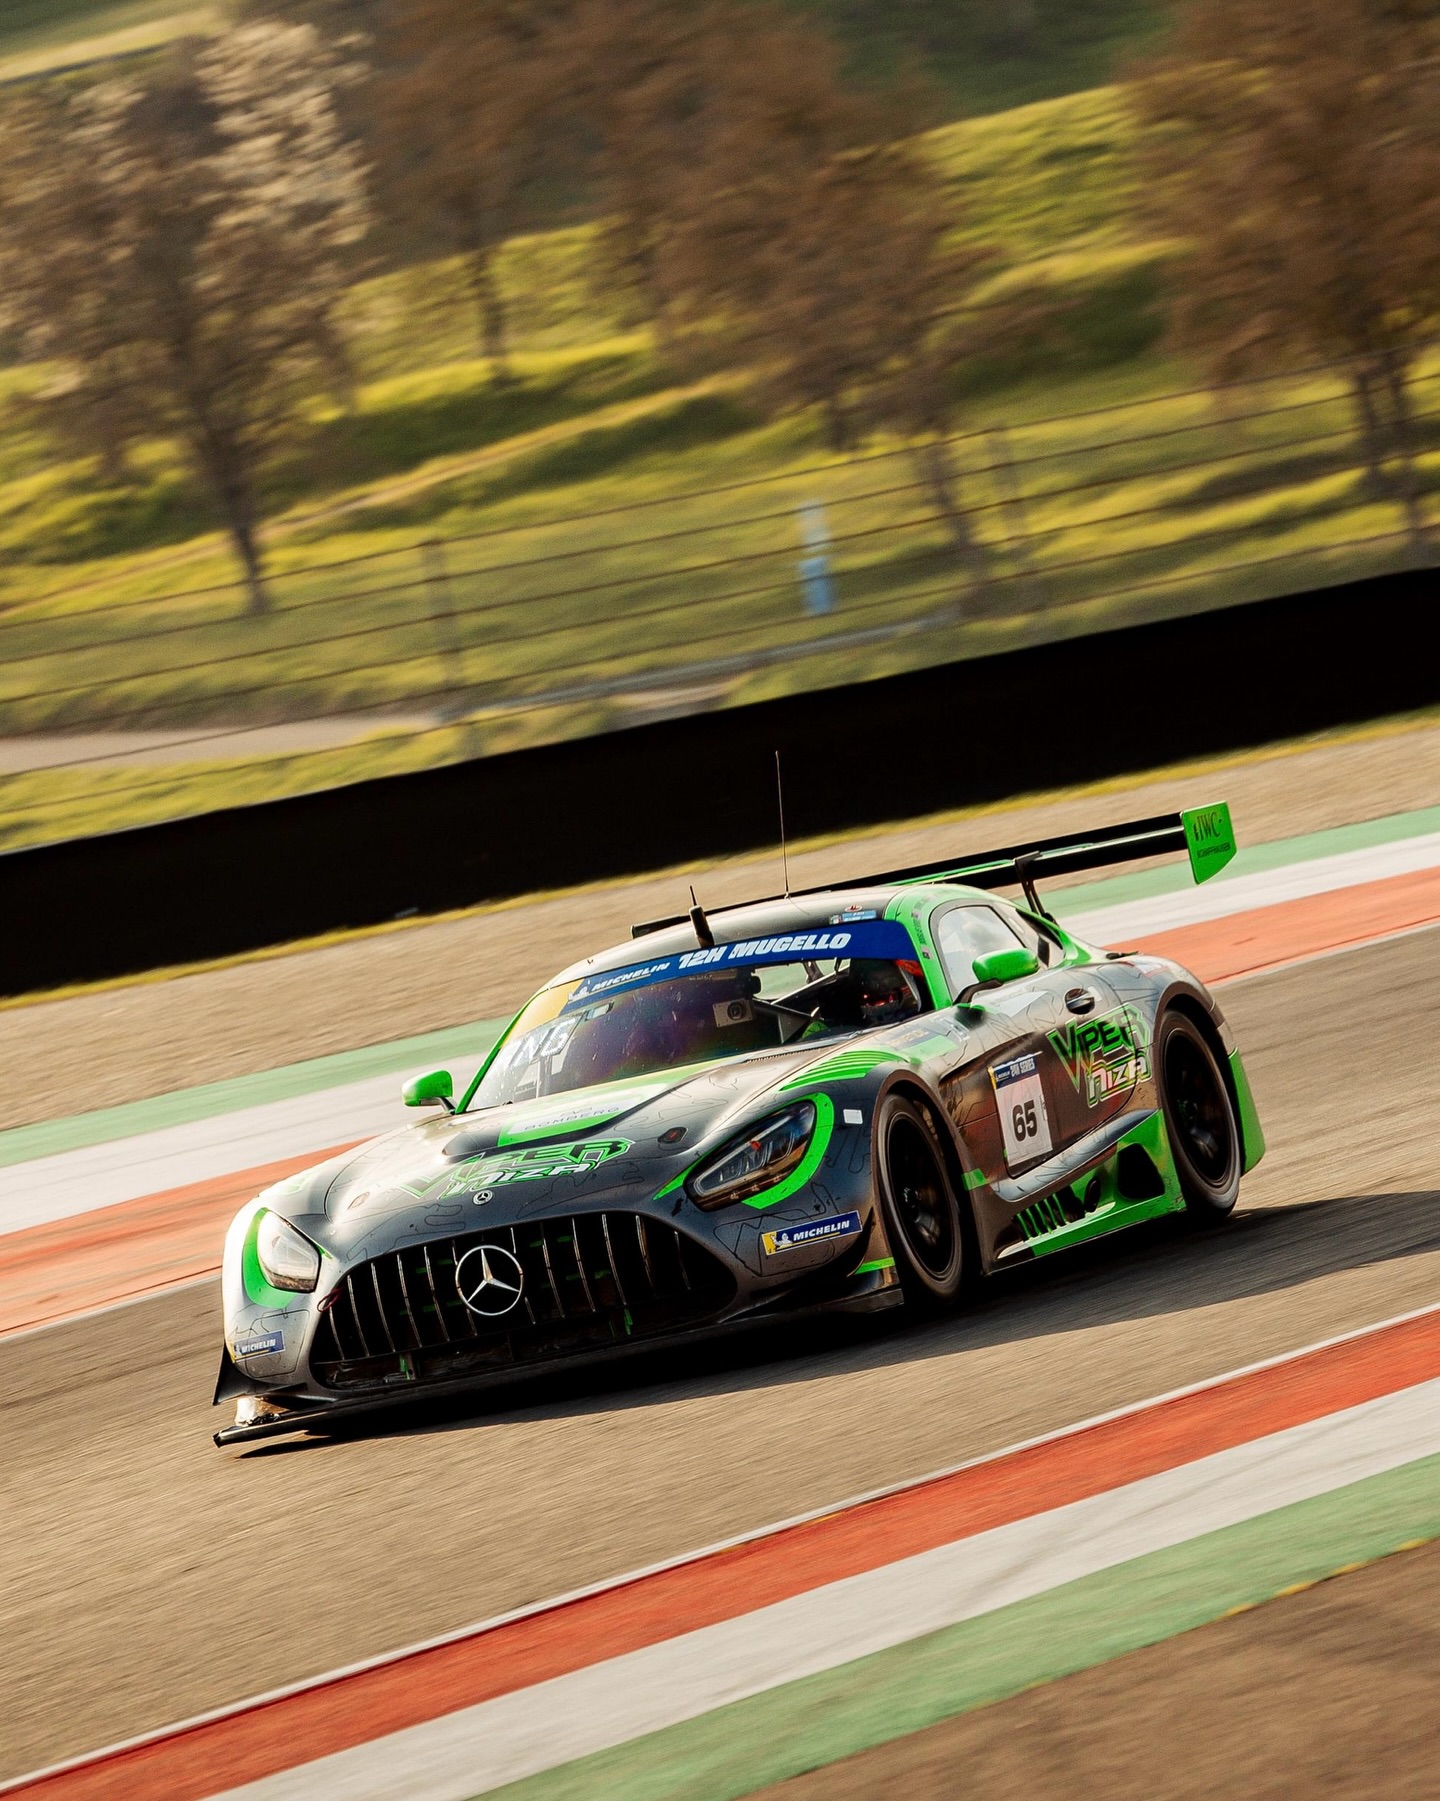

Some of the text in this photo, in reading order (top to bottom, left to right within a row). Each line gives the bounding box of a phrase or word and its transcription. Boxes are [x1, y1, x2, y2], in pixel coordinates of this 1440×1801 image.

[678, 933, 852, 969] 12H MUGELLO
[592, 962, 670, 992] MICHELIN
[1045, 1002, 1150, 1094] VIPER
[1012, 1099, 1038, 1142] 65
[793, 1220, 850, 1242] MICHELIN
